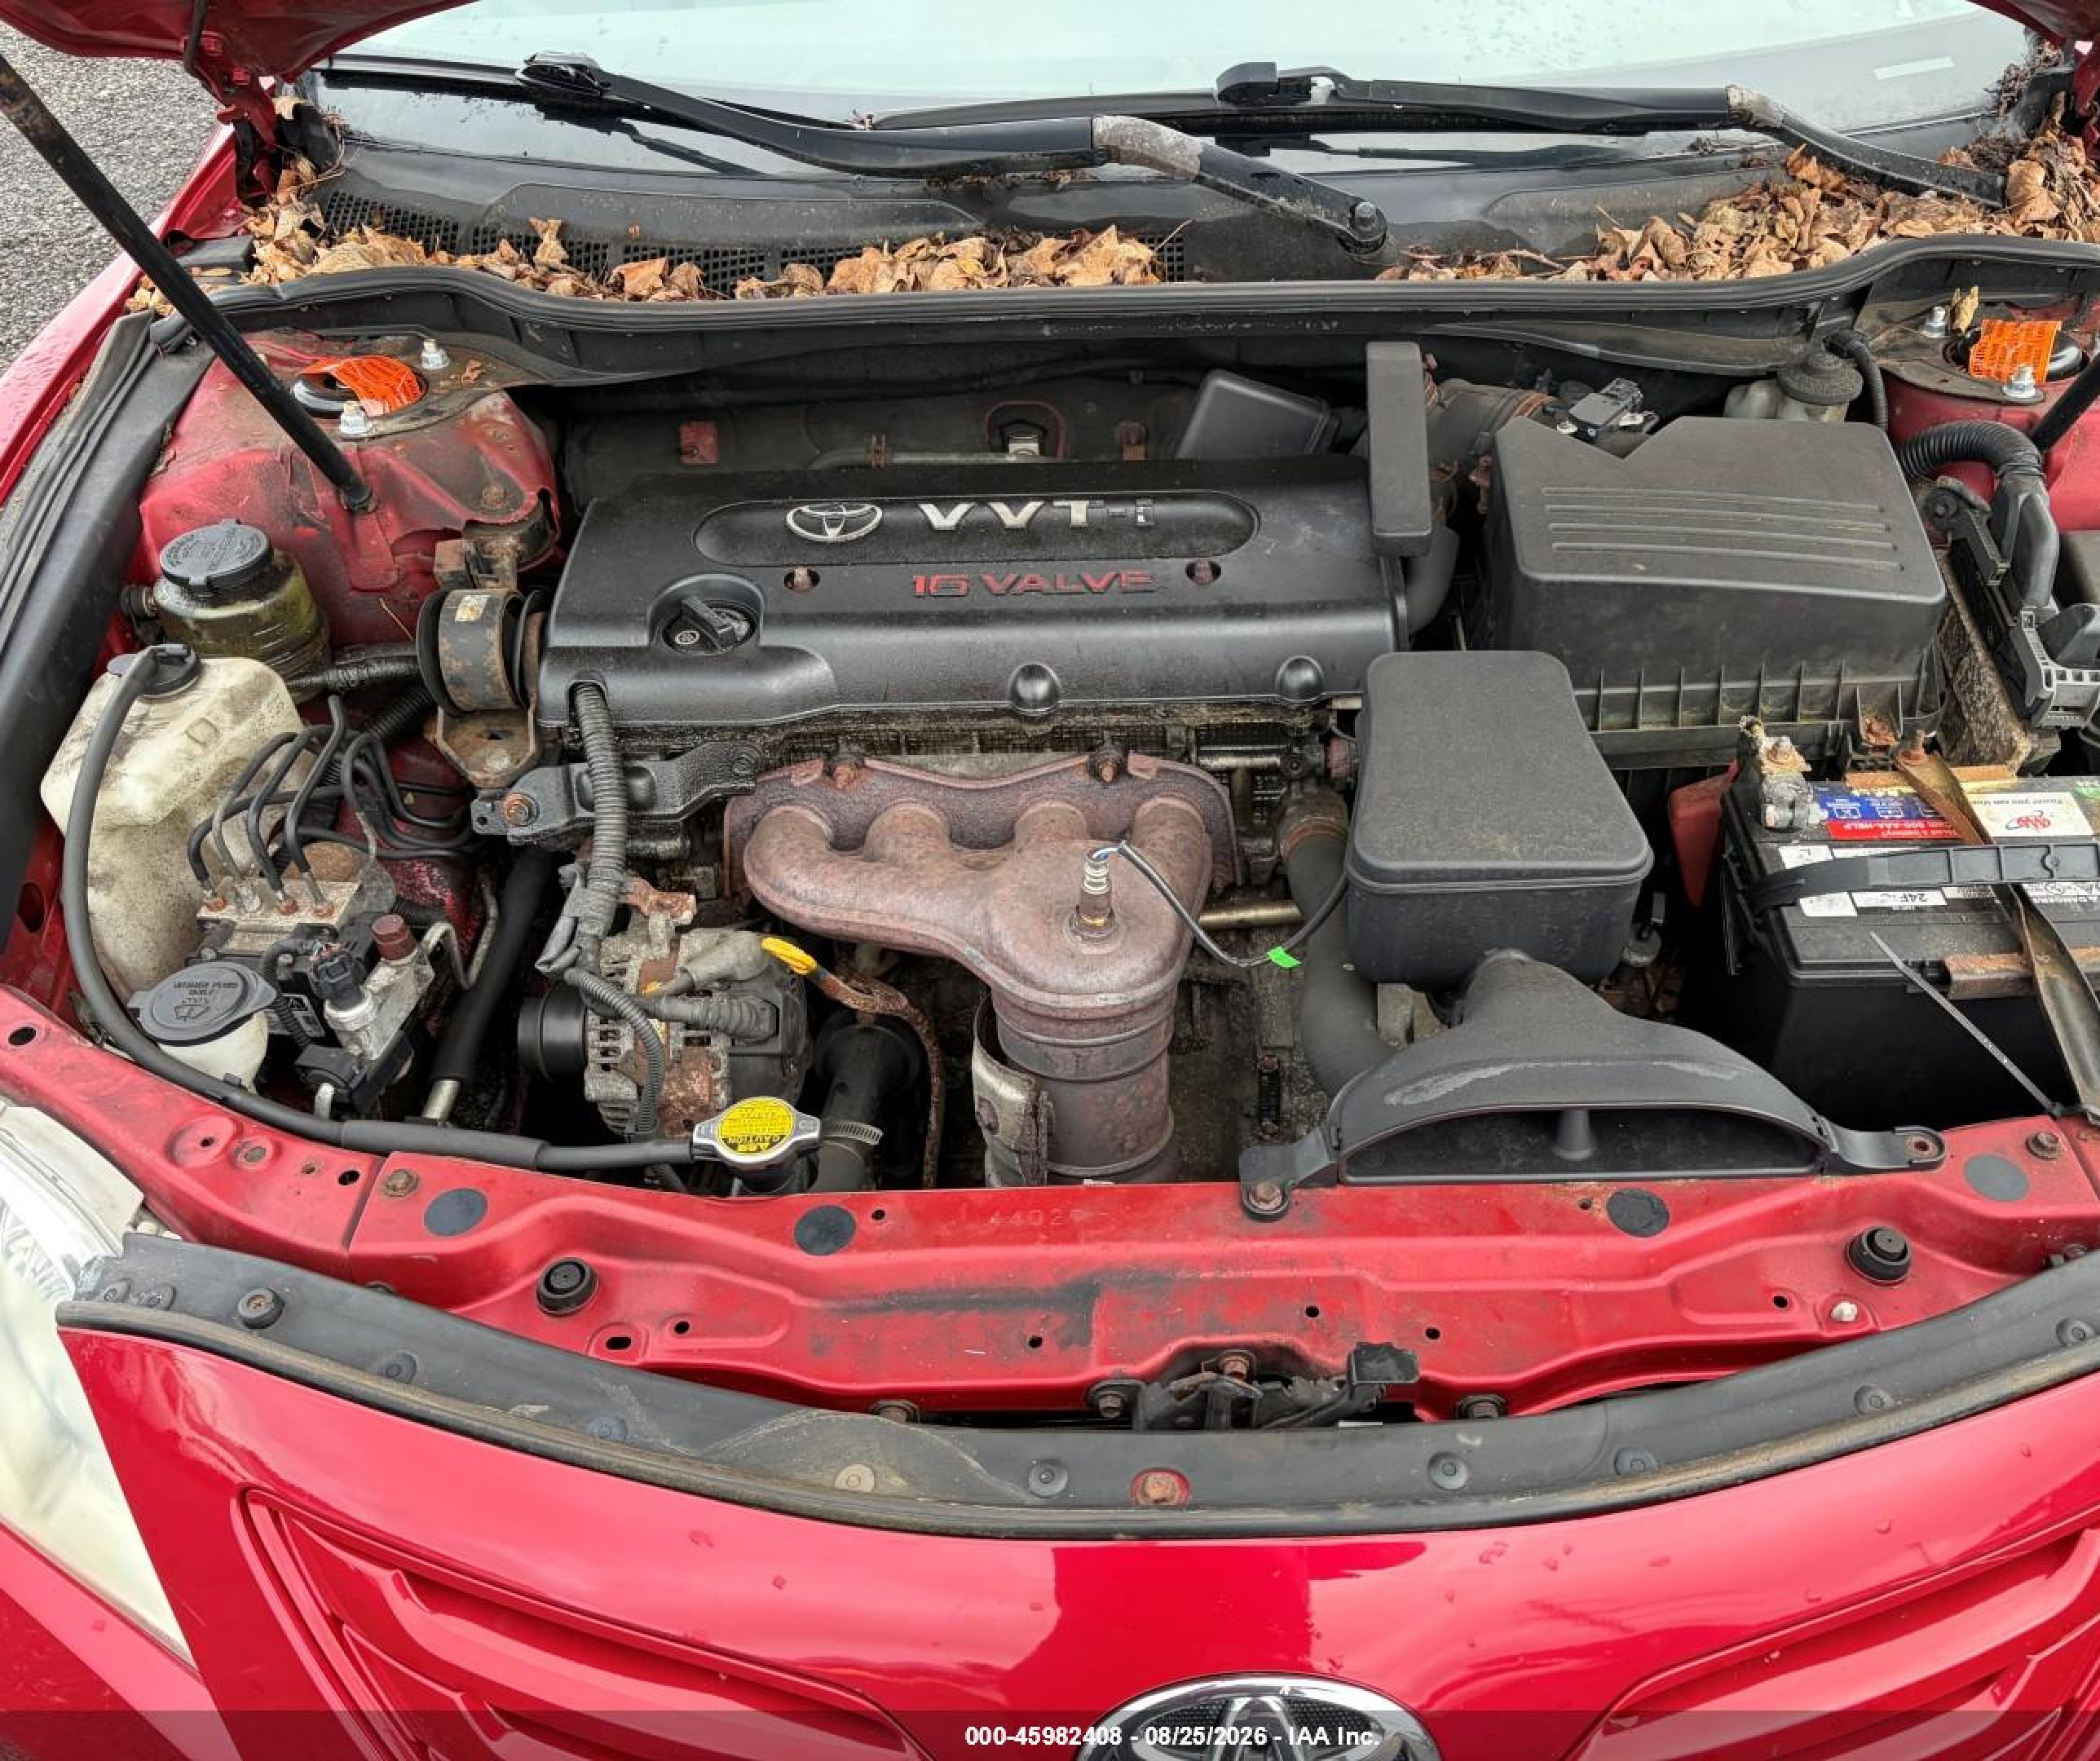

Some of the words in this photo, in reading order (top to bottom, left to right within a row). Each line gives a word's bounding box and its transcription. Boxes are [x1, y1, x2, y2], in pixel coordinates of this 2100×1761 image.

[917, 498, 1155, 530] VVT-i
[912, 572, 970, 597] 16
[982, 570, 1158, 596] VALVE
